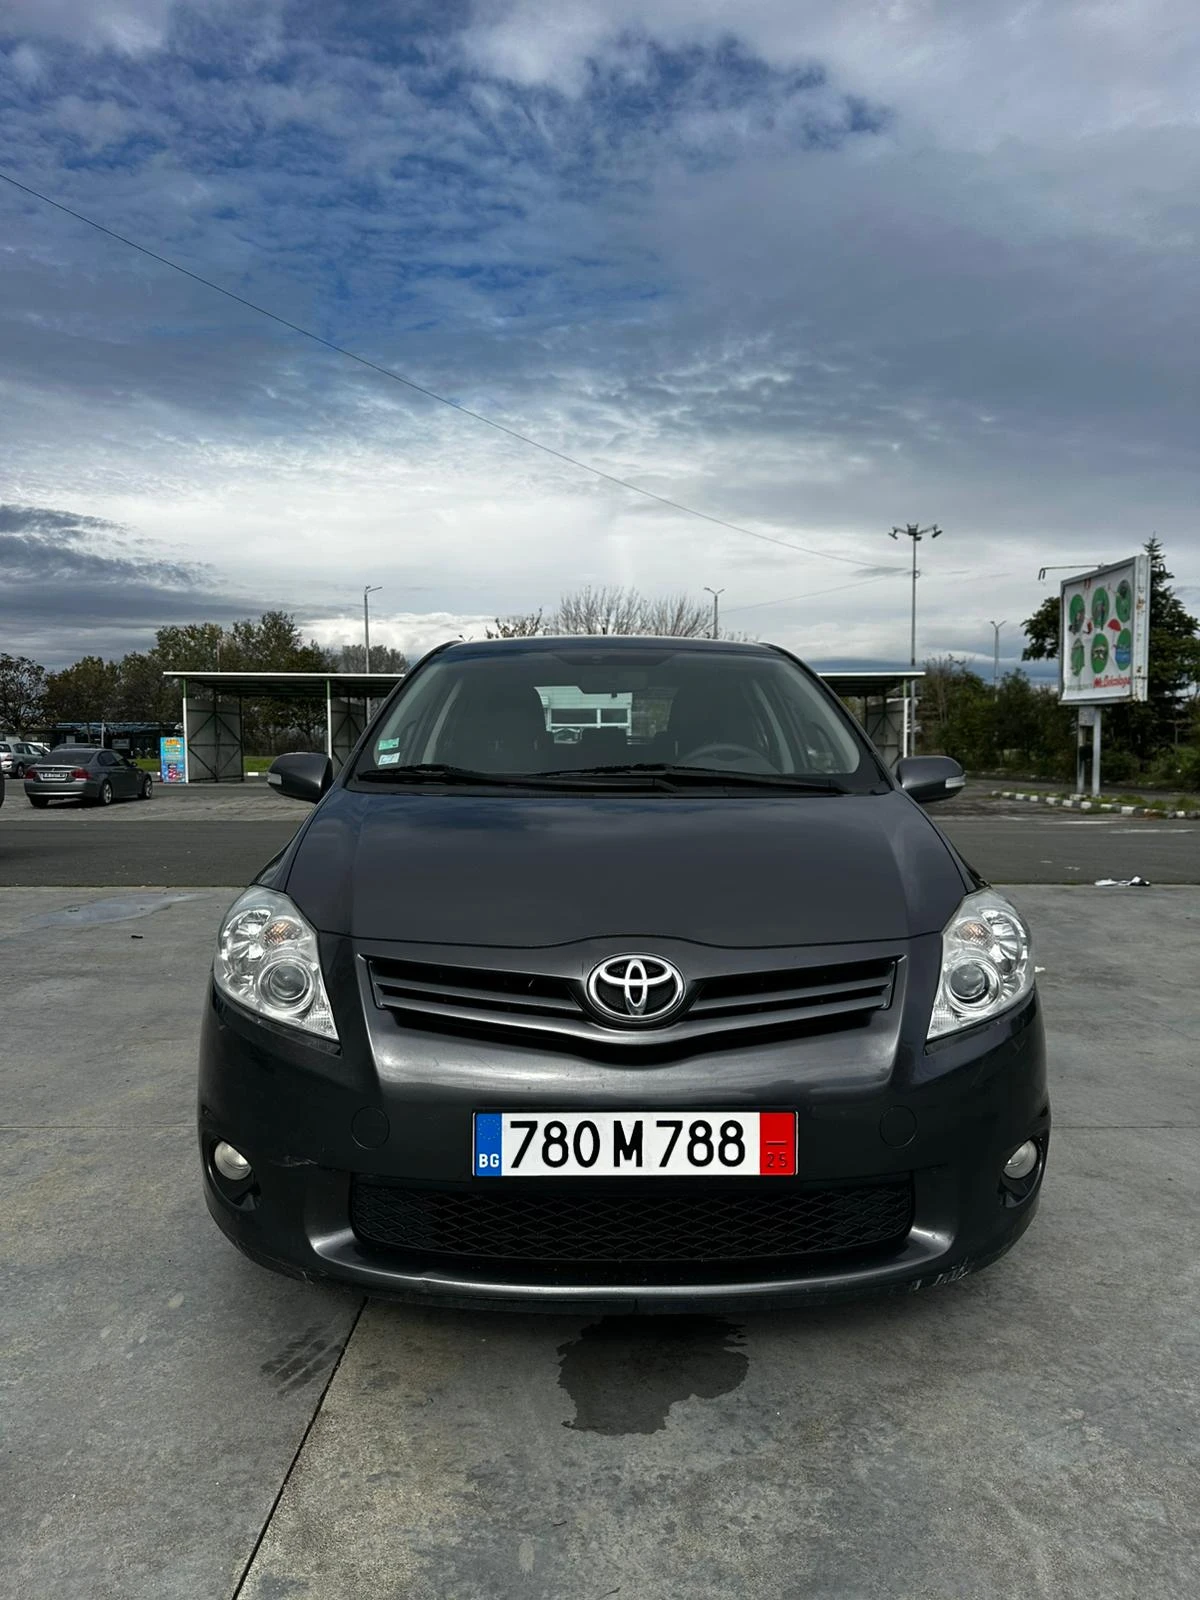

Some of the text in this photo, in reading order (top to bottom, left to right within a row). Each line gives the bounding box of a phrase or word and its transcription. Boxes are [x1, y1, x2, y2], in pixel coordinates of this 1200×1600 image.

[510, 1120, 746, 1169] 780 M 788
[479, 1153, 500, 1168] BG
[767, 1151, 788, 1168] 25
